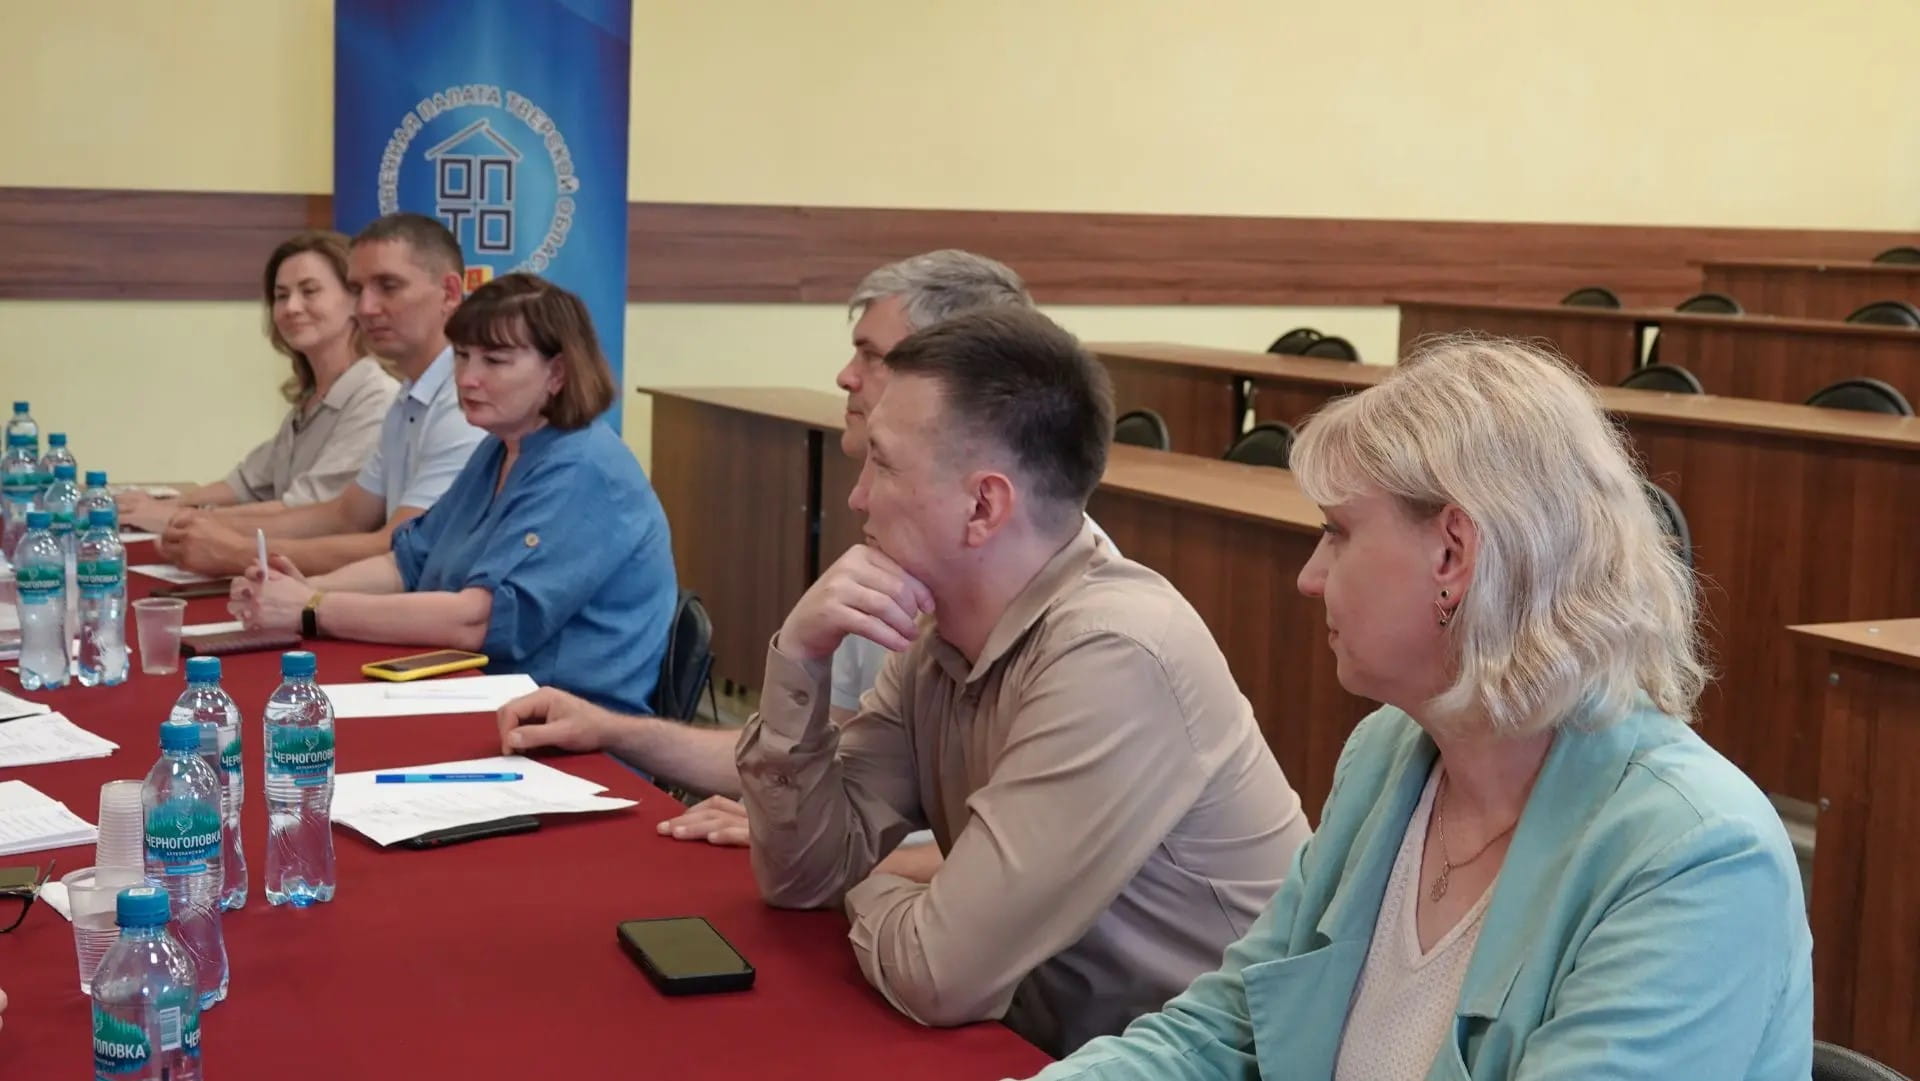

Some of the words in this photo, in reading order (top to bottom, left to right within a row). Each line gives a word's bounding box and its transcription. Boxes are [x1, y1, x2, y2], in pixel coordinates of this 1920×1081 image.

[378, 111, 423, 216] ТВЕННАЯ
[416, 84, 502, 122] ПАЛАТА
[507, 91, 580, 193] ТВЕРСКОЙ
[145, 831, 221, 849] ЧЕРНОГОЛОВКА
